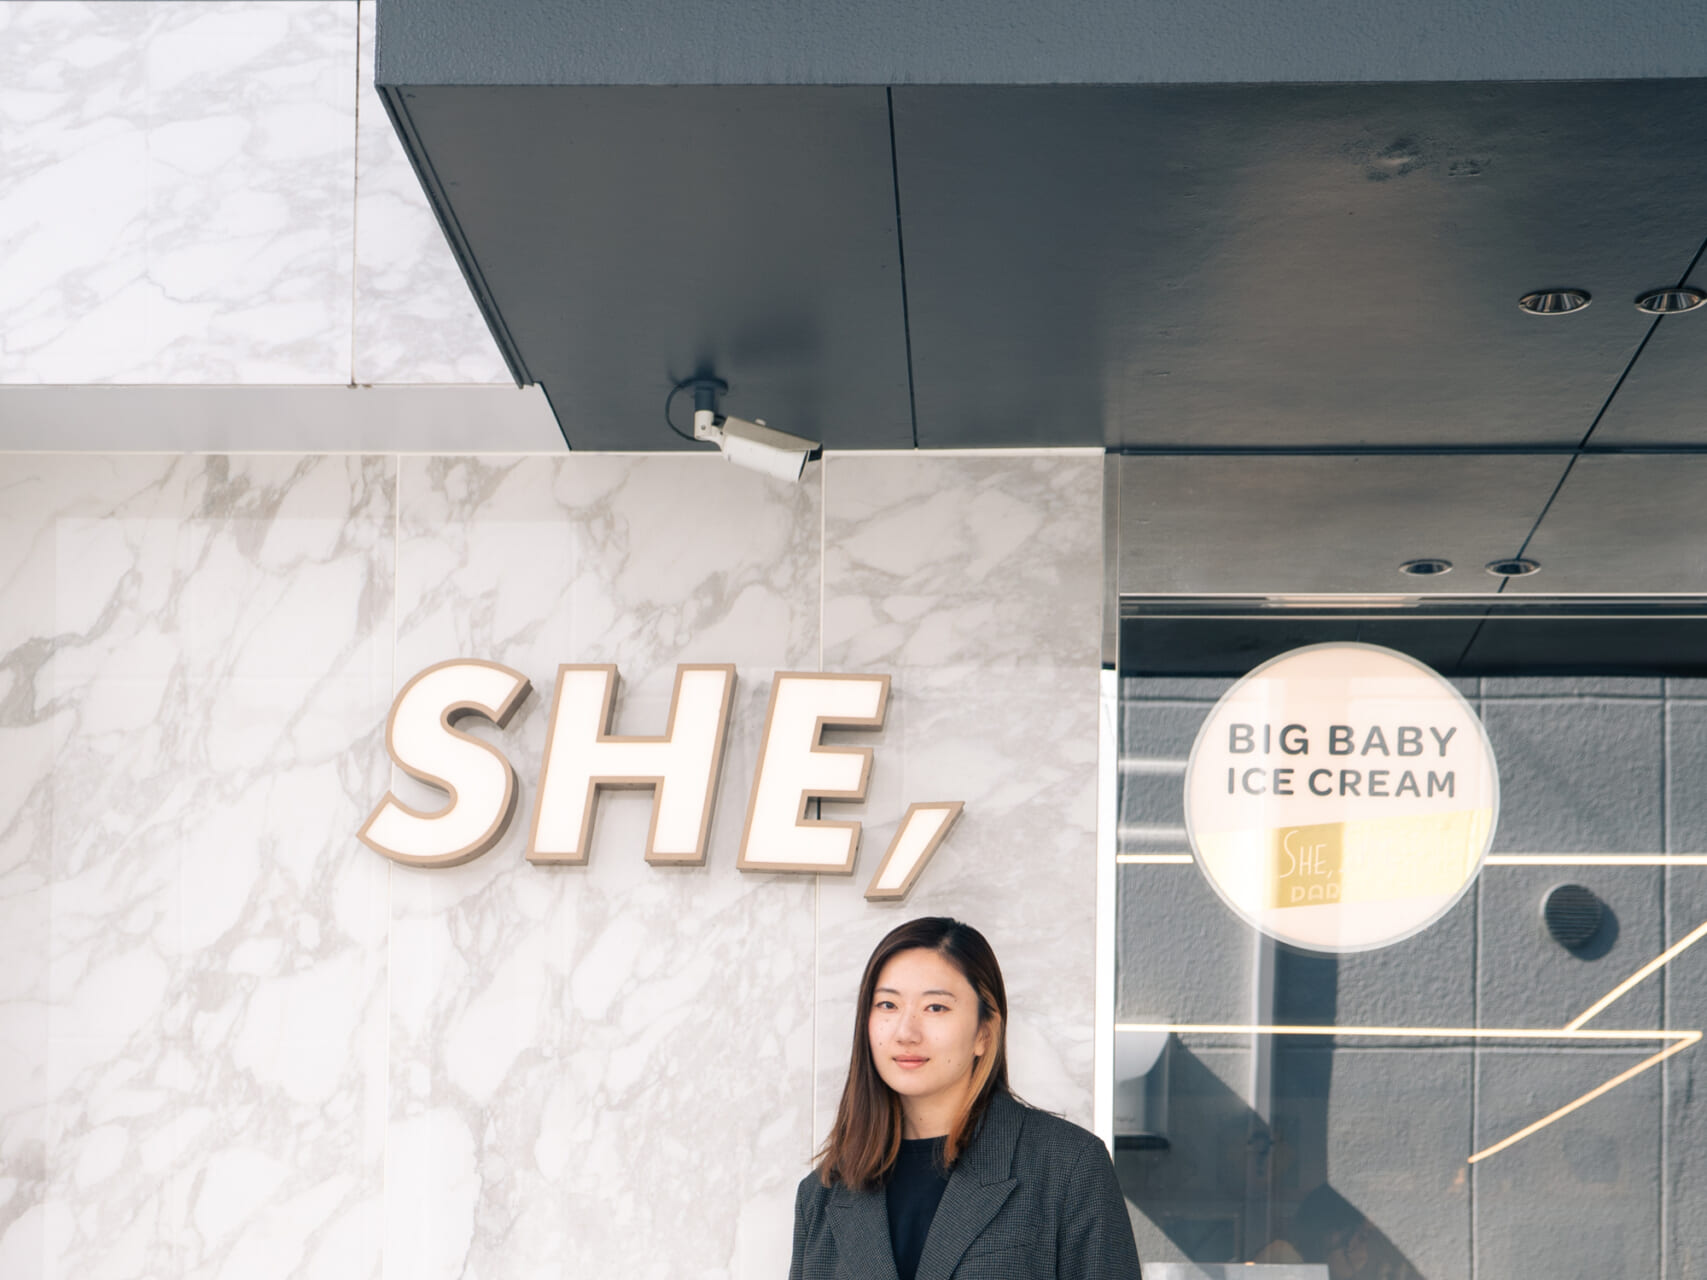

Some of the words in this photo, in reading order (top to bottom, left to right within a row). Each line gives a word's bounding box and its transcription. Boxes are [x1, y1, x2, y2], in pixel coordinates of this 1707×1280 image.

[1228, 723, 1310, 756] BIG
[1328, 725, 1458, 758] BABY
[355, 657, 966, 901] SHE,
[1227, 767, 1295, 796] ICE
[1308, 768, 1456, 799] CREAM
